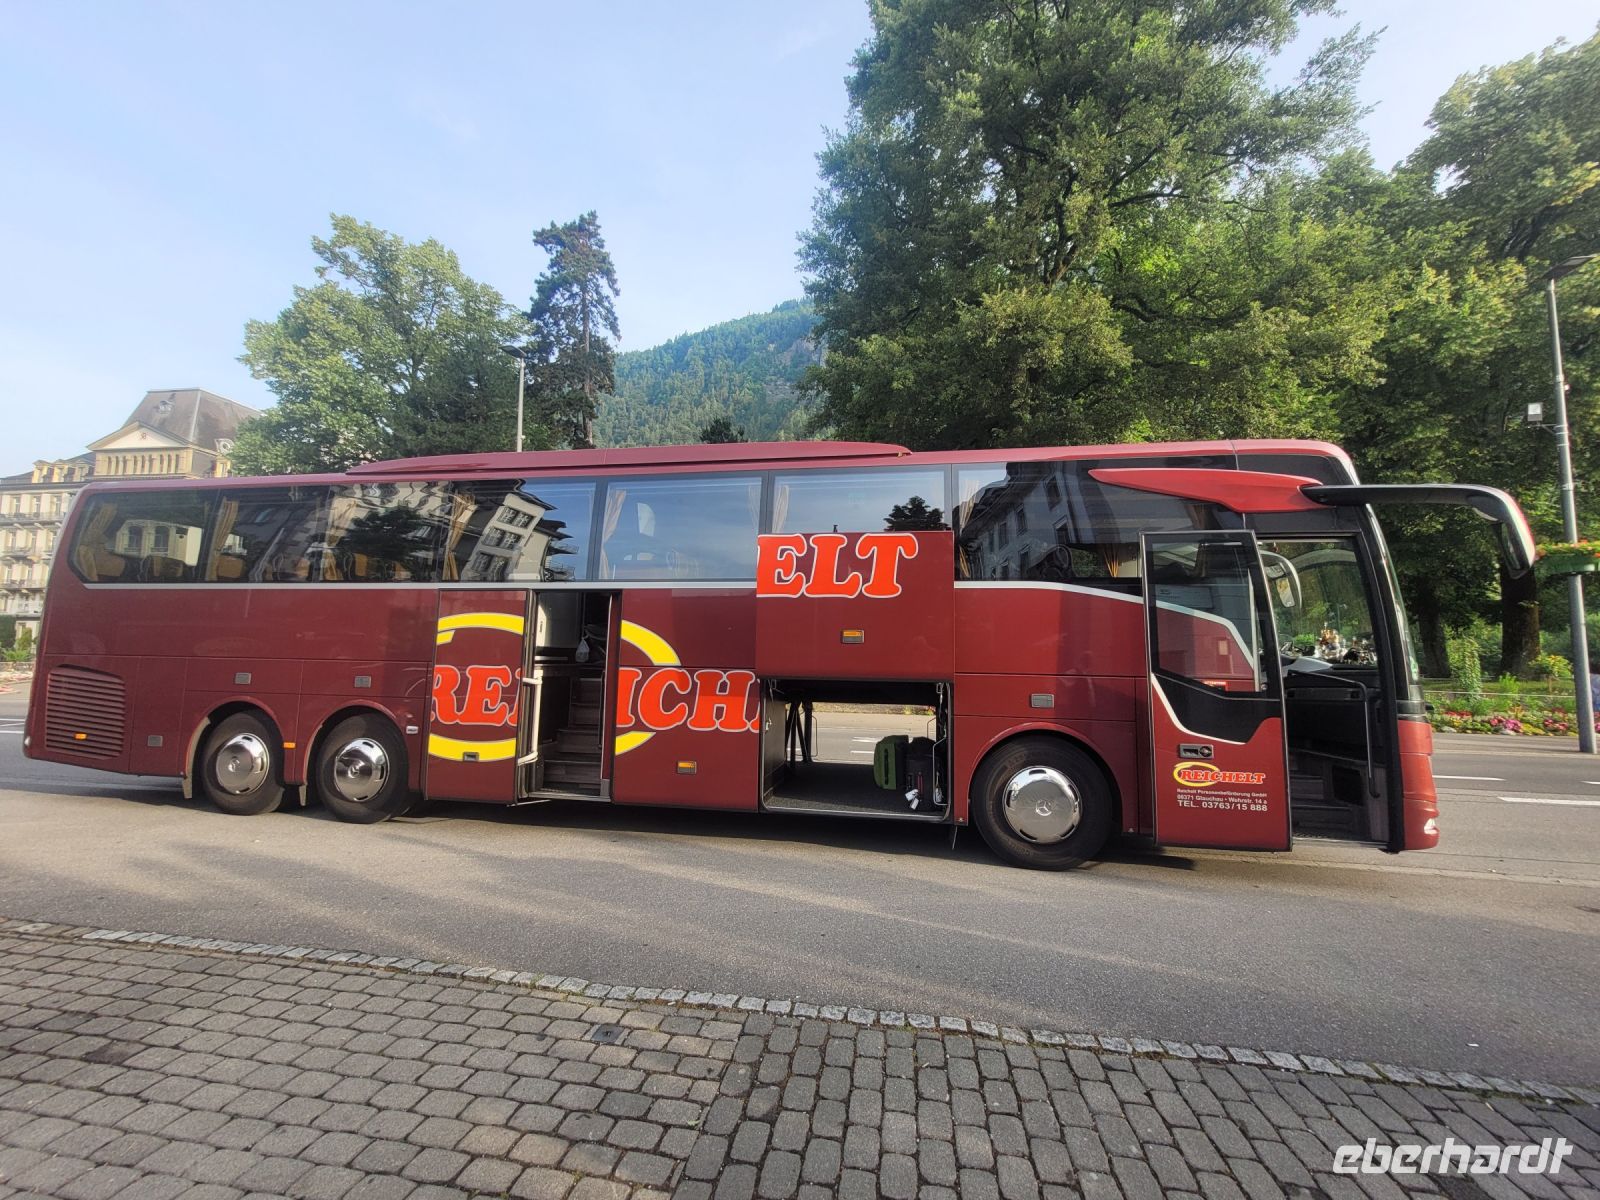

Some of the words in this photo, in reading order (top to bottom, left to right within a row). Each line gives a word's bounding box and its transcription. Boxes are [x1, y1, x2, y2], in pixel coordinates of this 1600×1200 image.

[756, 533, 918, 598] ELT
[431, 664, 518, 726] RE
[616, 667, 760, 733] ICH
[1180, 769, 1266, 784] REICHELT
[1177, 799, 1200, 808] TEL.
[1250, 804, 1268, 812] 888
